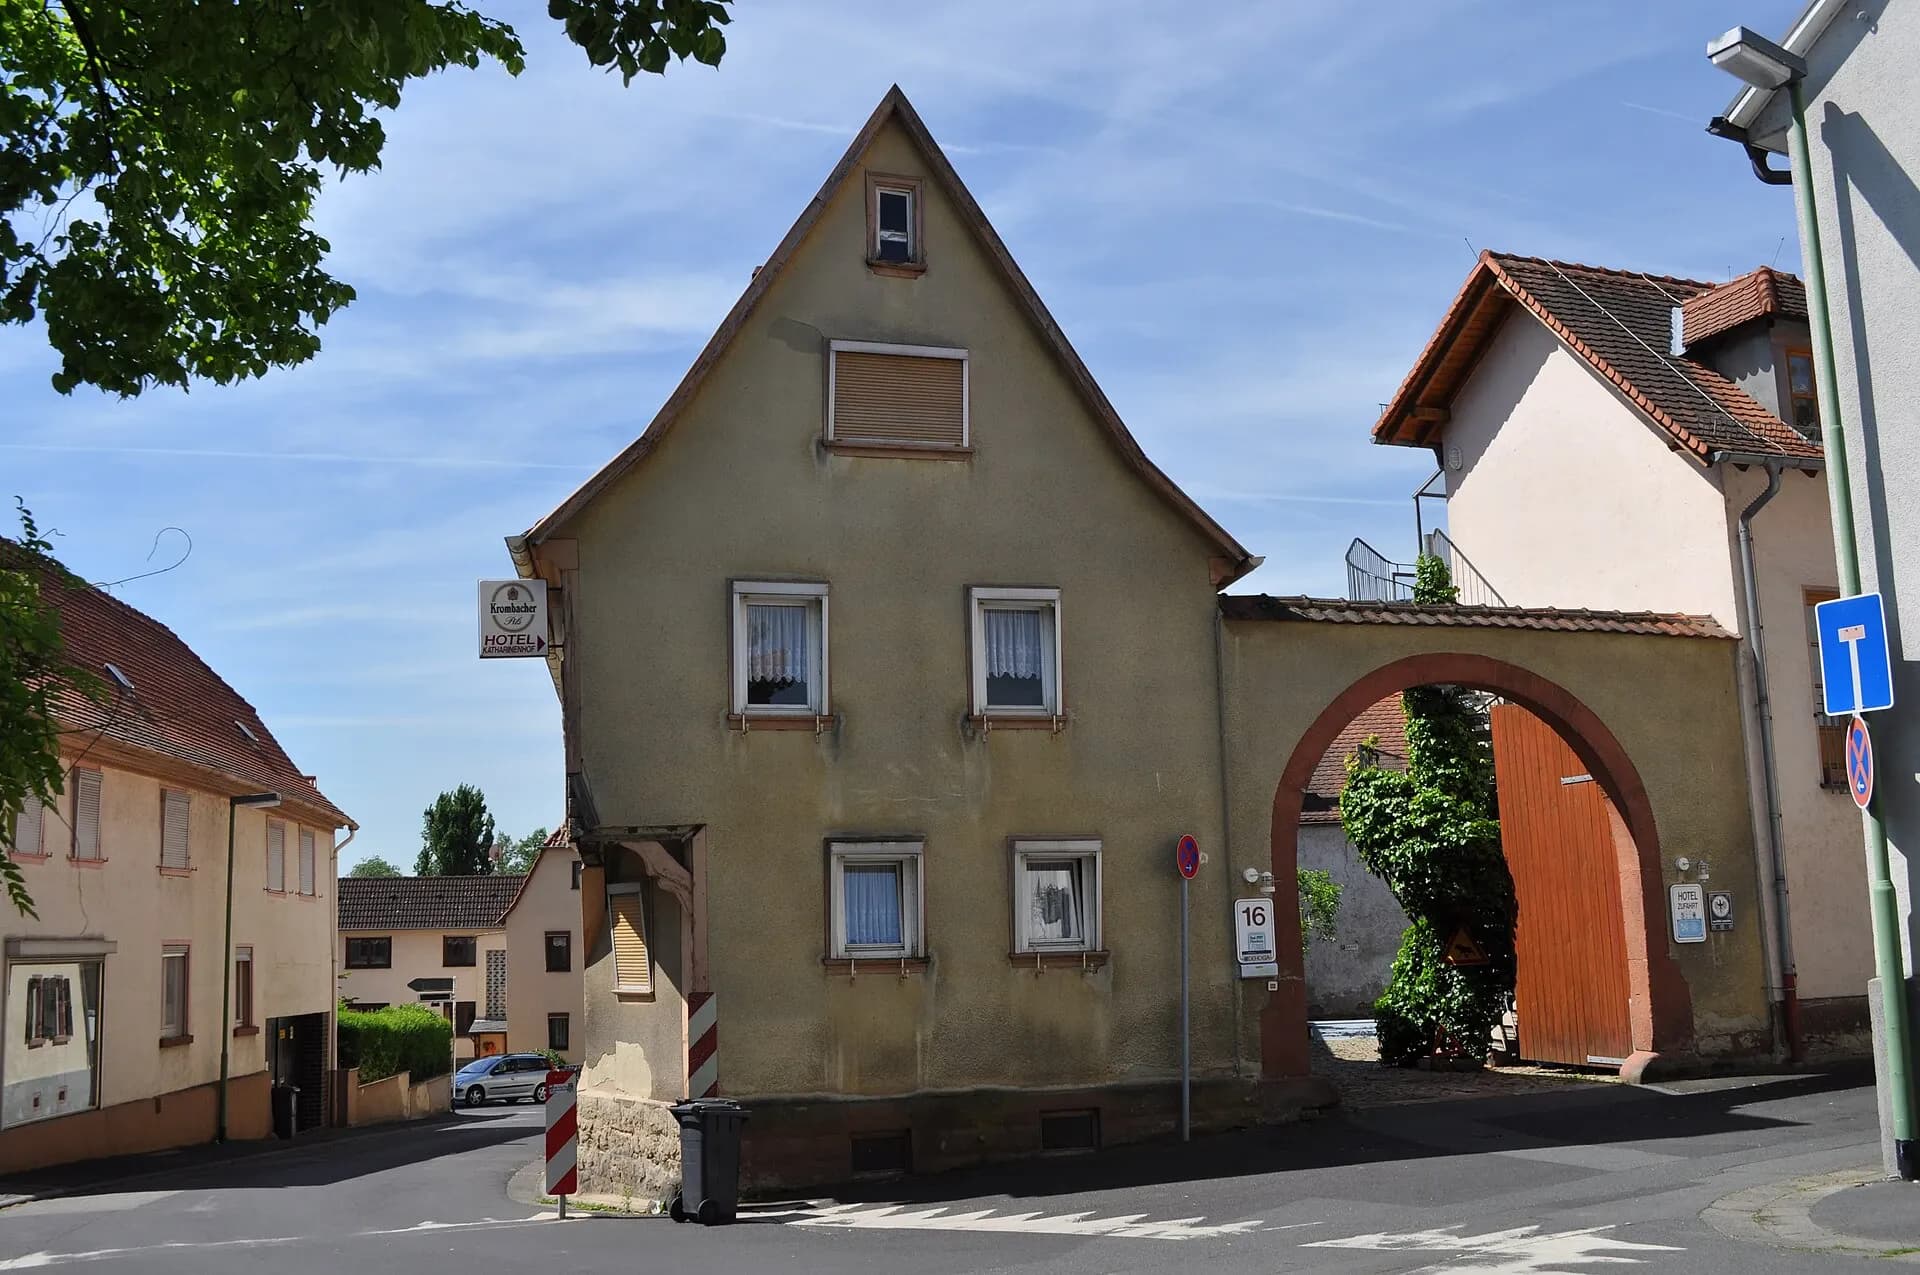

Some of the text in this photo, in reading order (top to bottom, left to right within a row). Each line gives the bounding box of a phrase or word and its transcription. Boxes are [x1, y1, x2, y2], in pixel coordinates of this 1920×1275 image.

[490, 602, 537, 614] Krombacher
[484, 634, 536, 646] HOTEL
[1677, 891, 1699, 902] HOTEL
[1241, 906, 1266, 927] 16
